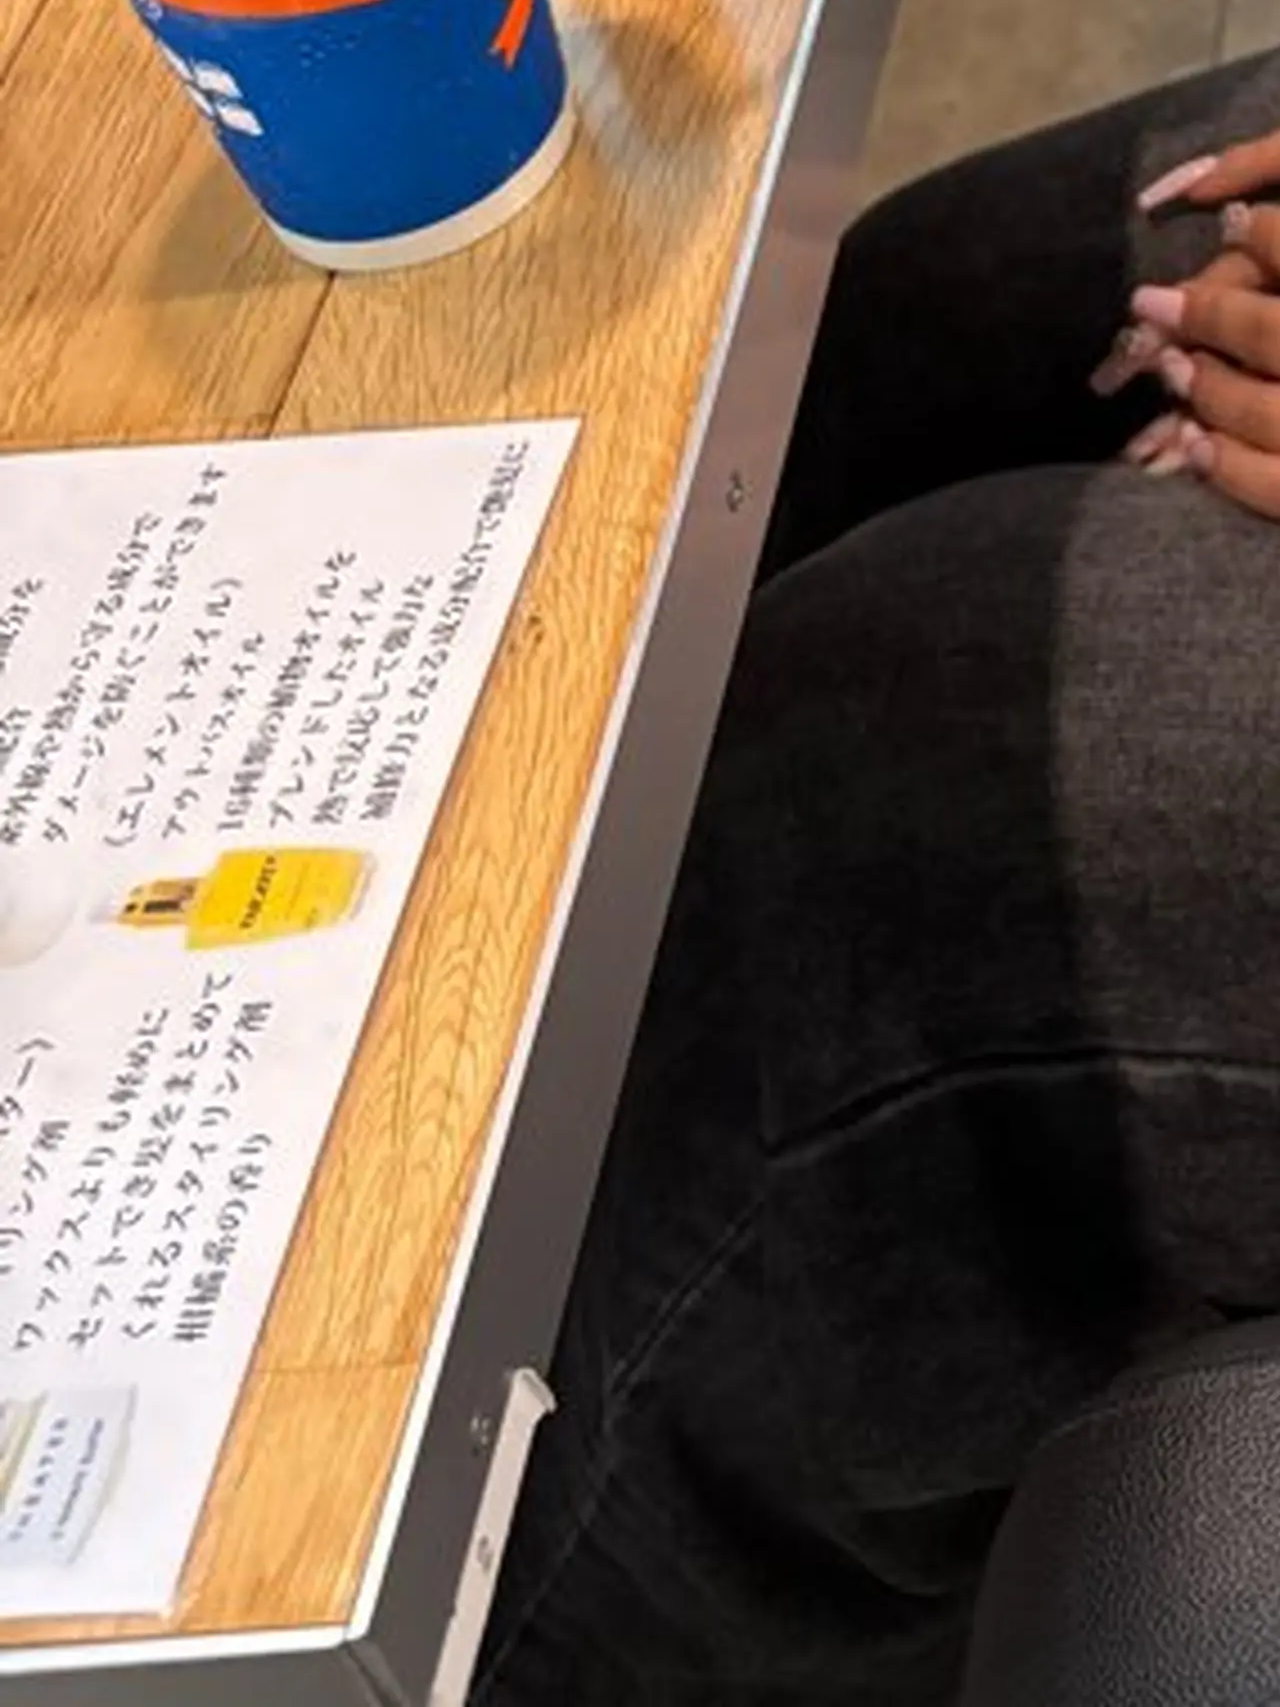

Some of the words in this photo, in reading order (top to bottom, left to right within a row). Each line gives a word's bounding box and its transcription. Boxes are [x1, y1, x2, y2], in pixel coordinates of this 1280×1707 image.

[42, 462, 227, 843] ダメージを防ぐことができます
[162, 631, 266, 839] アウトバスオイル
[269, 577, 385, 828] ブレンドしたオイル
[13, 1007, 169, 1350] ワックスよりも軽めに
[67, 973, 232, 1349] セットでき髪をまとめて
[121, 1001, 273, 1339] くれるスタイリング剤
[172, 1133, 272, 1342] 柑橘系の香り
